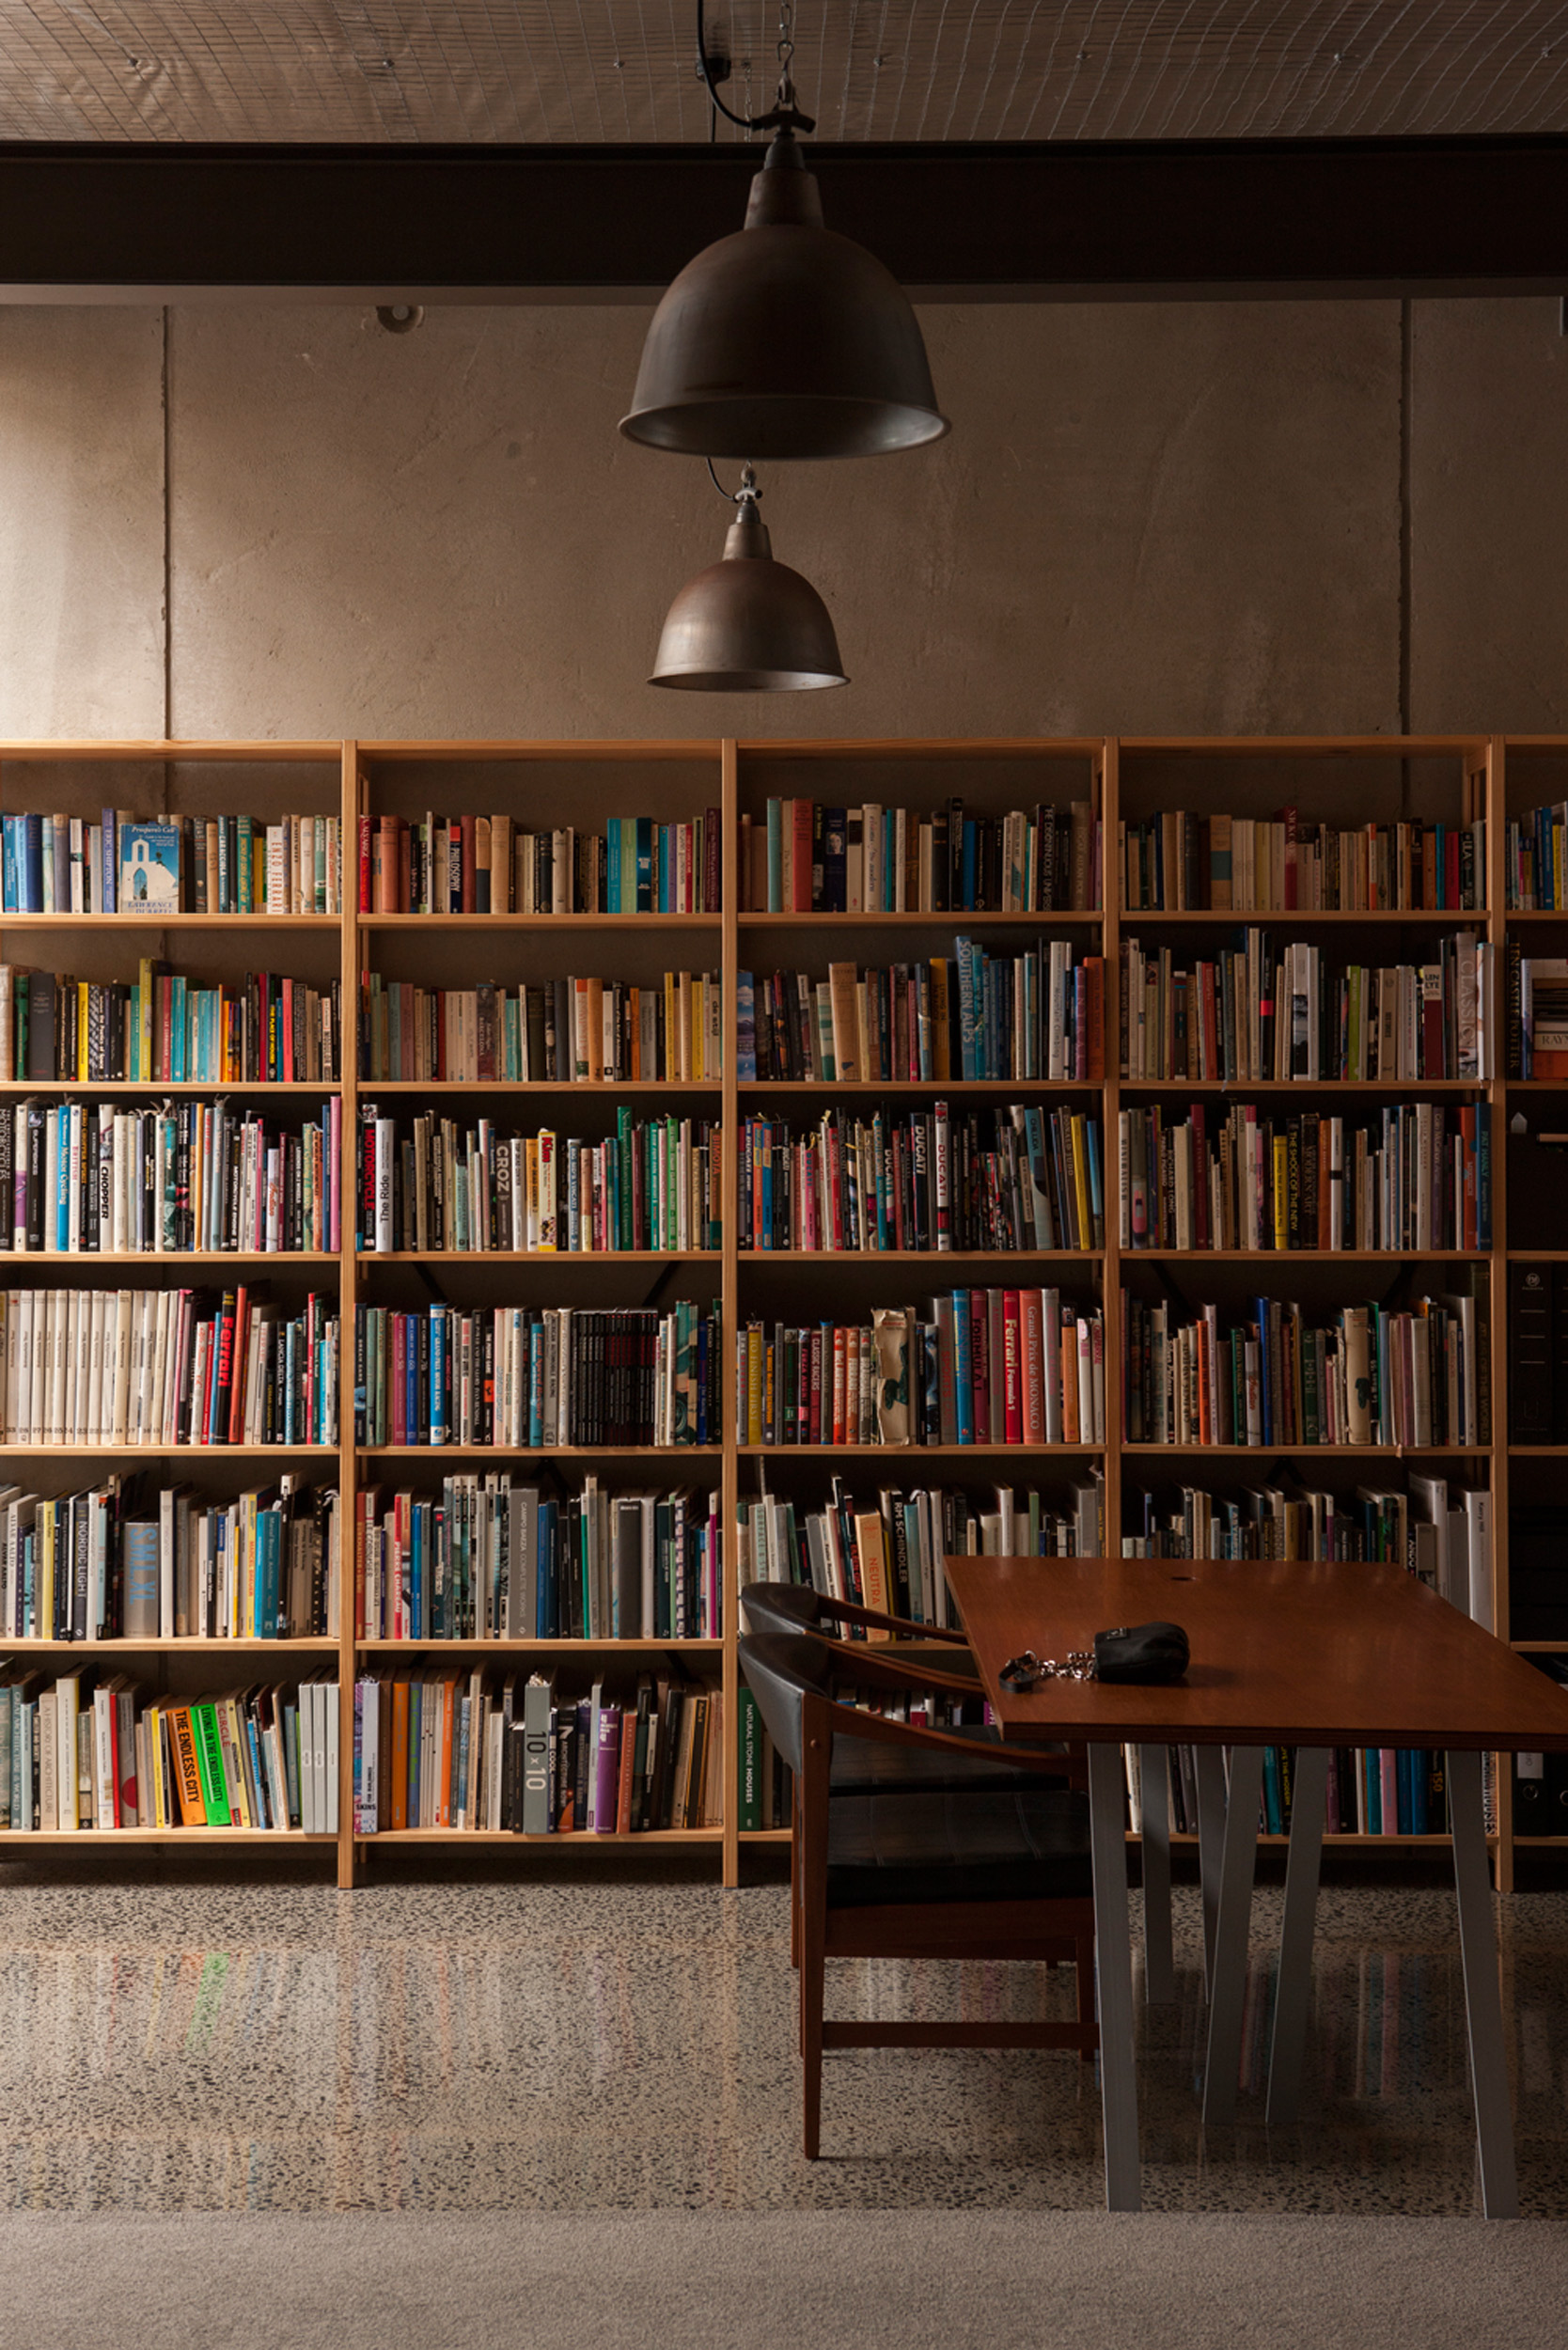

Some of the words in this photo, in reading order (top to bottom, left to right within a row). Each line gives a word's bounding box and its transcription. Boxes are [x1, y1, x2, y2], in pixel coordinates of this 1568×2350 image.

[272, 842, 283, 867] ENZO
[451, 848, 461, 892] PHILOSOPHY
[272, 872, 283, 913] FERRARI
[1510, 942, 1520, 966] LEN
[896, 972, 906, 998] HUTS
[960, 941, 973, 1010] SOUTHERN
[712, 1001, 719, 1015] de
[1053, 987, 1062, 1023] Mountain
[1460, 961, 1475, 1039] CLASSIC
[1510, 970, 1520, 1018] CASTLE
[963, 1011, 975, 1043] ALPS
[1053, 1025, 1062, 1058] Climbing
[1510, 1019, 1520, 1068] POTTER
[1030, 1118, 1039, 1151] CHILLIDA
[1063, 1115, 1072, 1151] DONALD
[1289, 1132, 1297, 1148] THE
[541, 1137, 554, 1163] Kim
[915, 1125, 927, 1175] DUCATI
[1289, 1149, 1297, 1178] SHOCK
[364, 1129, 376, 1211] MOTORCYCLE
[496, 1146, 510, 1193] CROZ
[885, 1150, 893, 1192] DUCATI
[938, 1144, 947, 1197] DUCATI
[59, 1174, 69, 1206] Cycling
[269, 1183, 278, 1216] Indian
[381, 1175, 390, 1199] Ride
[1289, 1180, 1297, 1192] OF
[1289, 1193, 1297, 1209] THE
[381, 1202, 390, 1224] The
[1289, 1210, 1297, 1230] NEW
[940, 1313, 949, 1348] WORLD
[959, 1309, 969, 1360] GRAND
[1027, 1307, 1038, 1338] Grand
[218, 1317, 234, 1386] Ferrari
[750, 1339, 759, 1353] TO
[972, 1318, 982, 1383] FORMULA
[1005, 1319, 1018, 1368] Ferrari
[1027, 1340, 1038, 1362] Prix
[1093, 1325, 1102, 1365] CHAPARRAL
[750, 1355, 759, 1390] FINISH
[848, 1357, 856, 1390] FERRARI
[942, 1351, 951, 1398] SPORTS
[959, 1361, 970, 1385] PRIX
[1029, 1364, 1039, 1376] de
[1007, 1369, 1015, 1404] Formula
[1248, 1376, 1258, 1410] Indian
[750, 1394, 759, 1421] FIRST
[944, 1401, 953, 1427] CARS
[1029, 1378, 1040, 1430] MONACO
[894, 1502, 903, 1518] RM
[77, 1521, 88, 1565] NORDIC
[267, 1517, 275, 1538] Marcel
[267, 1539, 275, 1559] Breuer,
[851, 1544, 859, 1571] EILEEN
[895, 1521, 908, 1584] SCHINDLER
[77, 1566, 88, 1598] LIGHT
[128, 1528, 157, 1605] S,M,L,XL
[267, 1561, 275, 1590] Architect
[869, 1558, 881, 1605] NEUTRA
[411, 1690, 419, 1710] Glass
[44, 1715, 53, 1744] HISTORY
[175, 1711, 189, 1731] THE
[201, 1707, 214, 1732] LIVING
[217, 1708, 231, 1747] CIRCLE
[411, 1712, 419, 1755] Construction
[44, 1745, 53, 1756] OF
[204, 1732, 215, 1741] IN
[207, 1742, 218, 1755] THE
[526, 1731, 545, 1754] 10
[179, 1733, 196, 1778] ENDLESS
[411, 1758, 419, 1784] Manual
[560, 1741, 569, 1789] ARCHITECTURE
[44, 1758, 53, 1814] ARCHITECTURE
[209, 1757, 222, 1787] ENDLESS
[526, 1768, 545, 1791] 10
[185, 1780, 200, 1803] CITY
[213, 1788, 224, 1803] CITY
[560, 1790, 569, 1808] NOW!
